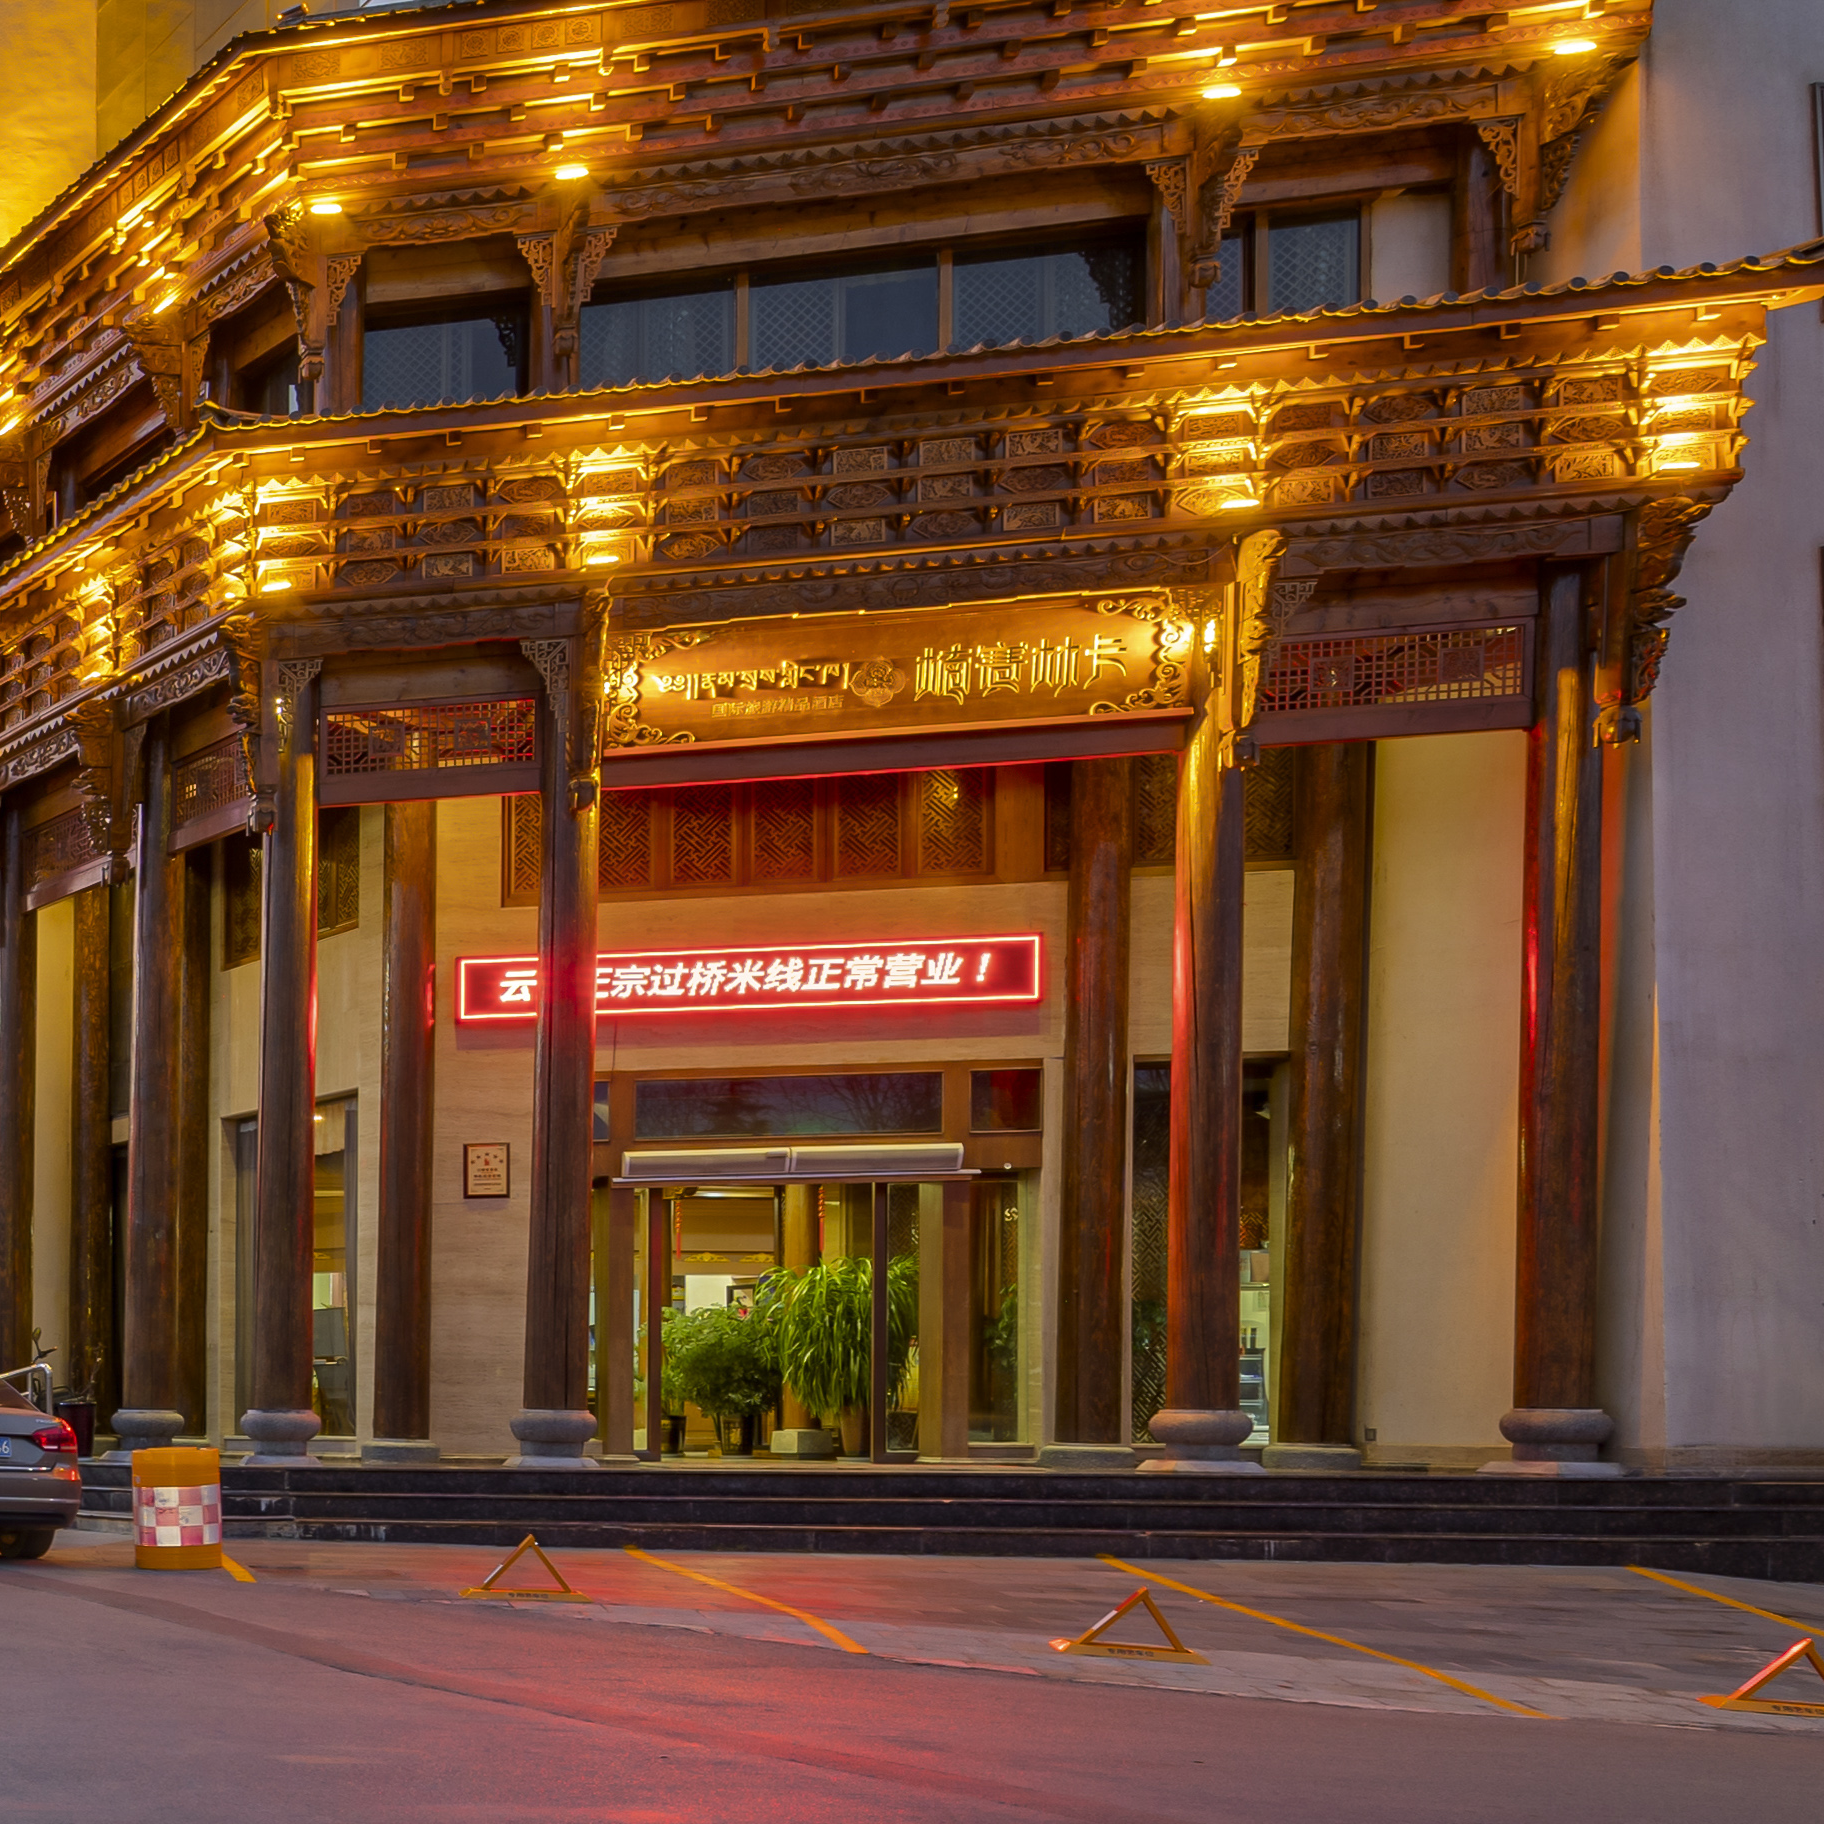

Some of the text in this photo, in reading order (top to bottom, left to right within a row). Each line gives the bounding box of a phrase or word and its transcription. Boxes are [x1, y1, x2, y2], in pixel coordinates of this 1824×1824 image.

[711, 694, 845, 718] 国际旅游精品酒店
